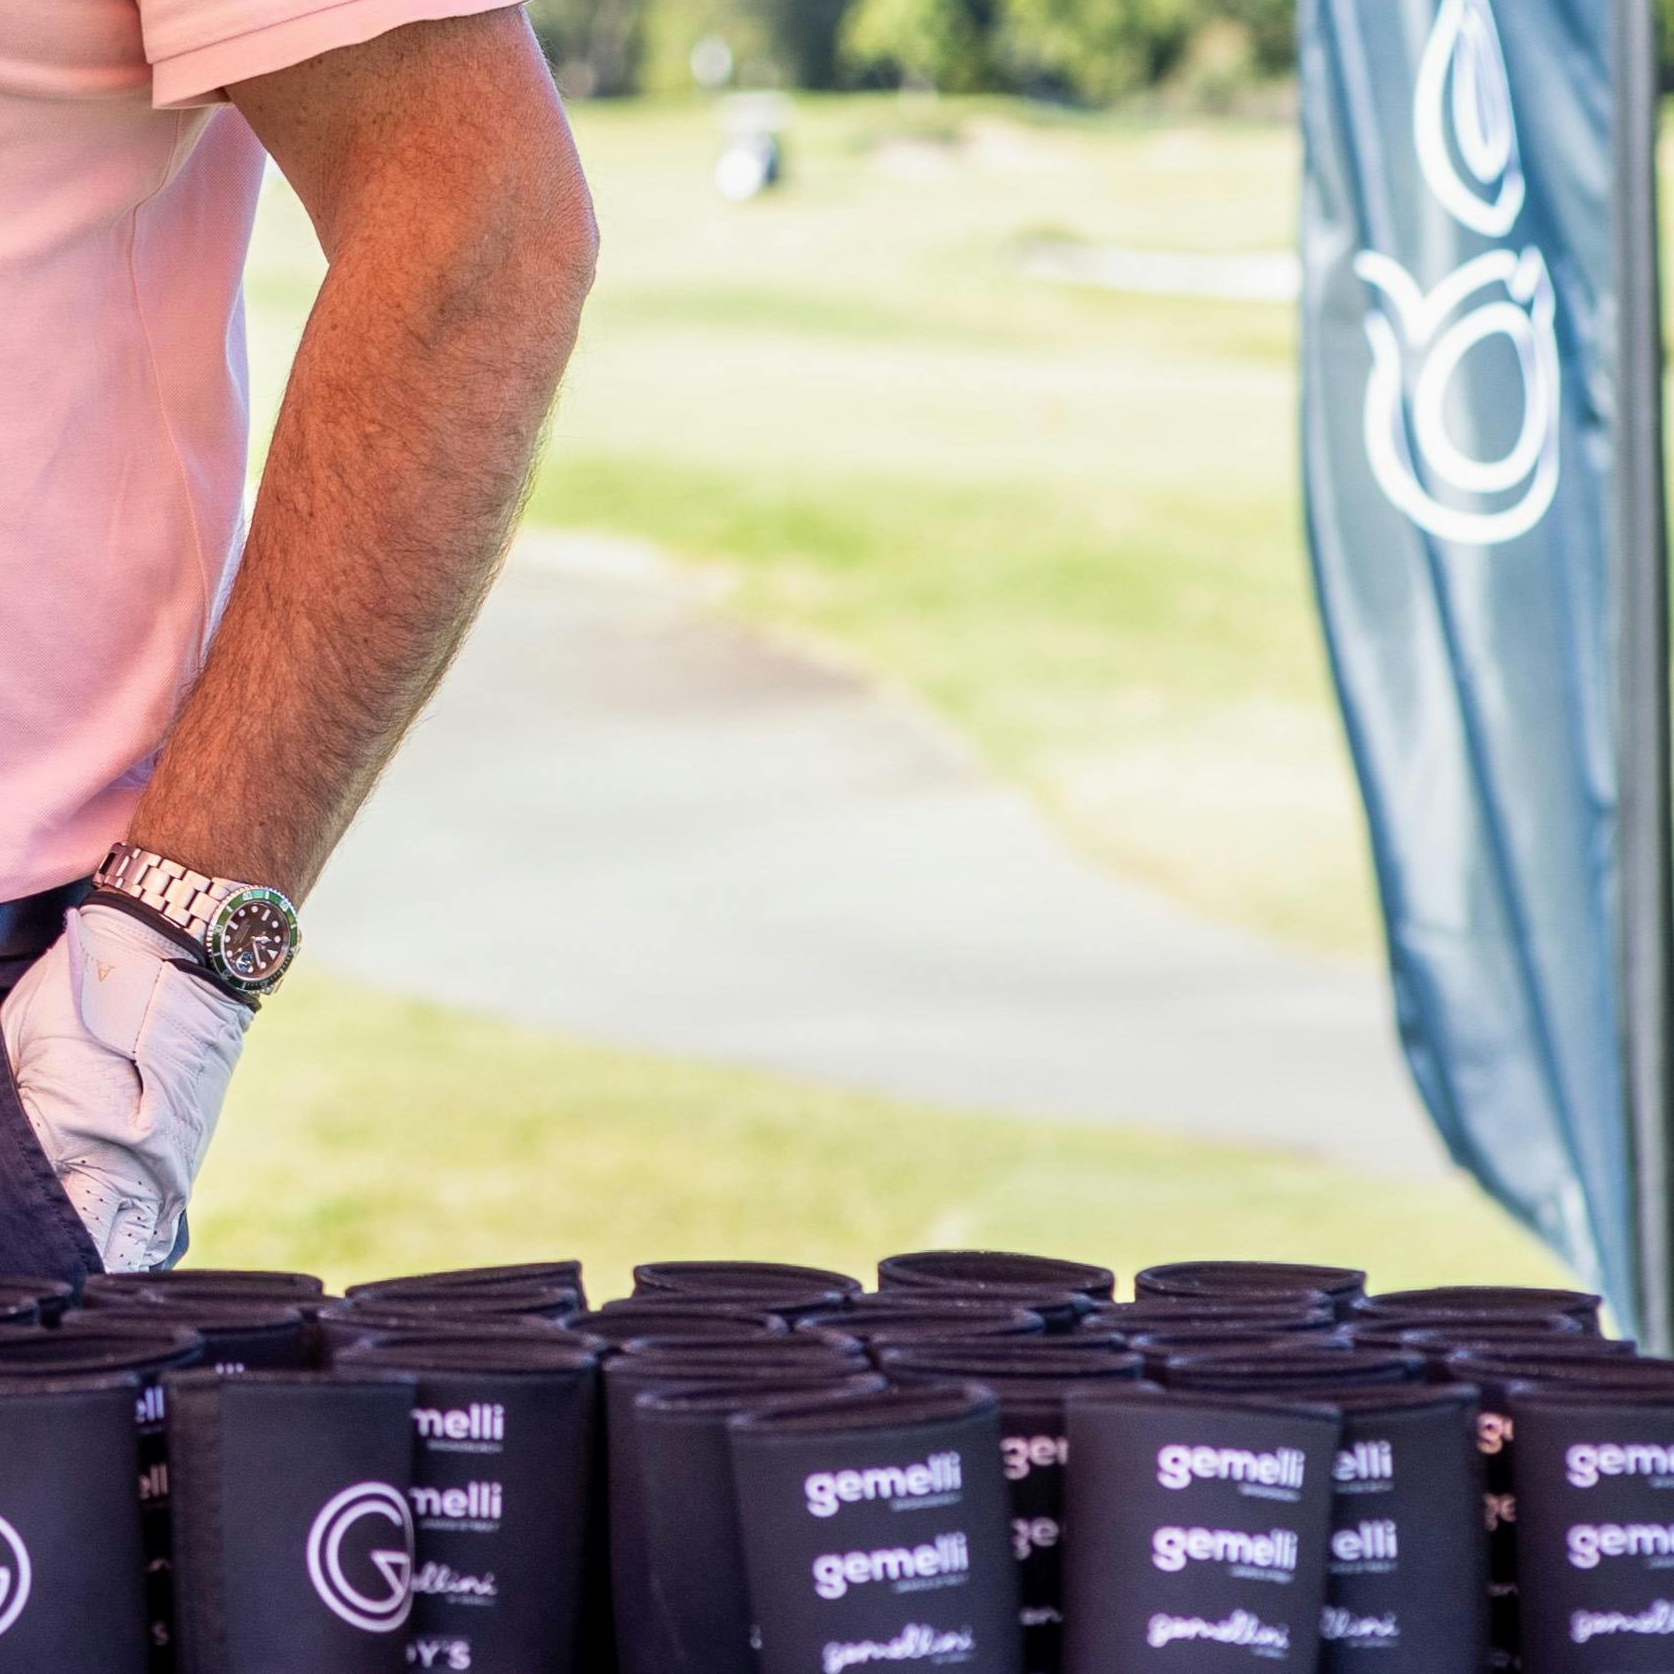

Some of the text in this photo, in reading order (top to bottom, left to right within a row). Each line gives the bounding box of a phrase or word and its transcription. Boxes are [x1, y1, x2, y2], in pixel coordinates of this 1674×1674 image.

[804, 1450, 963, 1518] gemelli
[1156, 1443, 1306, 1490] gemelli
[1151, 1525, 1299, 1573] gemelli
[1330, 1518, 1399, 1561] elli
[812, 1530, 970, 1600] gemelli
